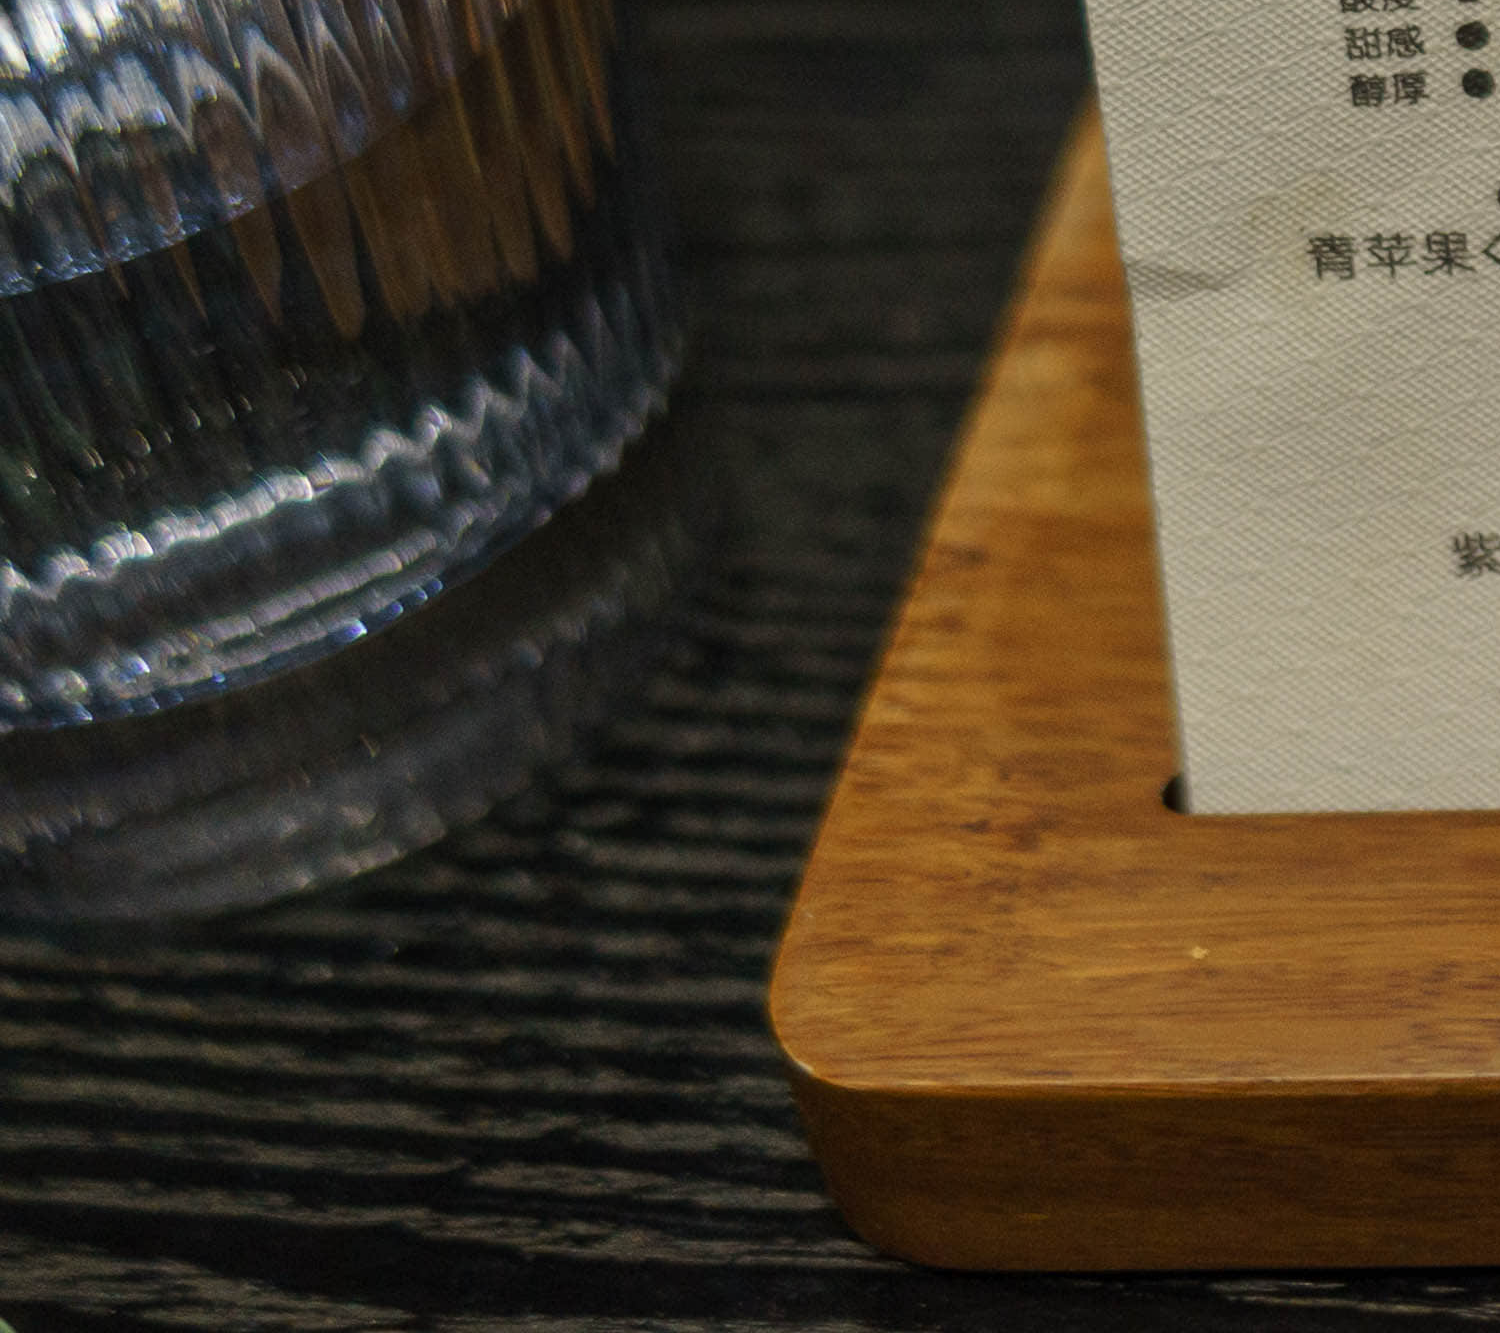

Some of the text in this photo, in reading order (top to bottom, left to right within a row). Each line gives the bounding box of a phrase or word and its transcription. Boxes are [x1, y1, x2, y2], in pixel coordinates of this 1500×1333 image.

[1344, 24, 1427, 61] 甜感
[1348, 70, 1429, 108] 醇厚
[1305, 230, 1476, 281] 青苹果
